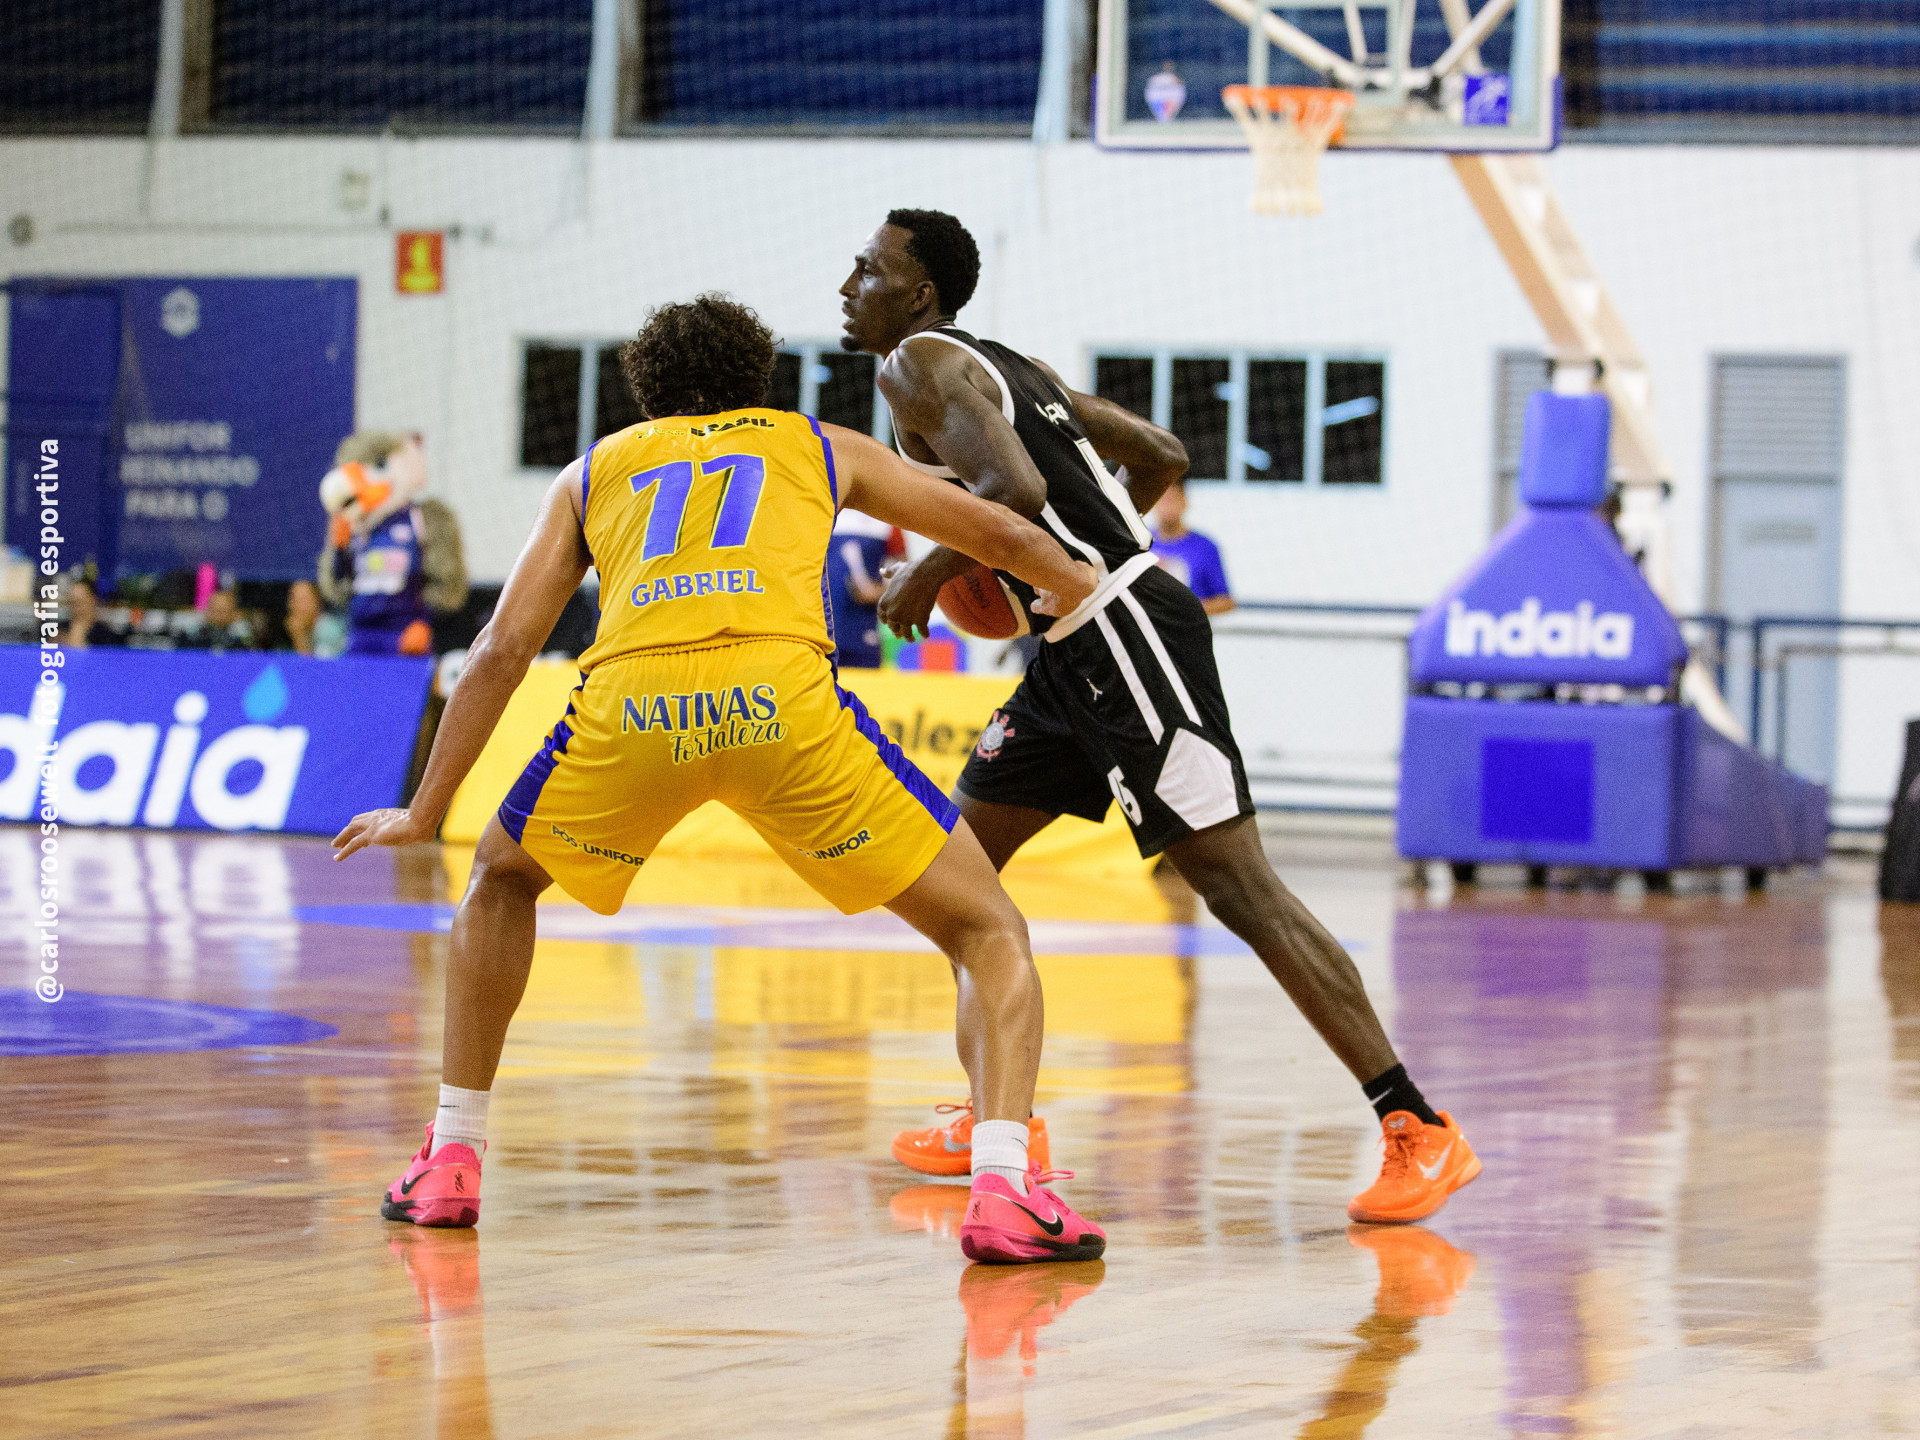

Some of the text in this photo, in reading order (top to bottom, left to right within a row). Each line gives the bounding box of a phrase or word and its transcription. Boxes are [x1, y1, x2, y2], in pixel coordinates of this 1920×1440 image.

[627, 453, 767, 565] 77
[630, 569, 765, 608] GABRIEL
[623, 684, 777, 732] NATIVAS
[670, 719, 786, 764] Fortaleza
